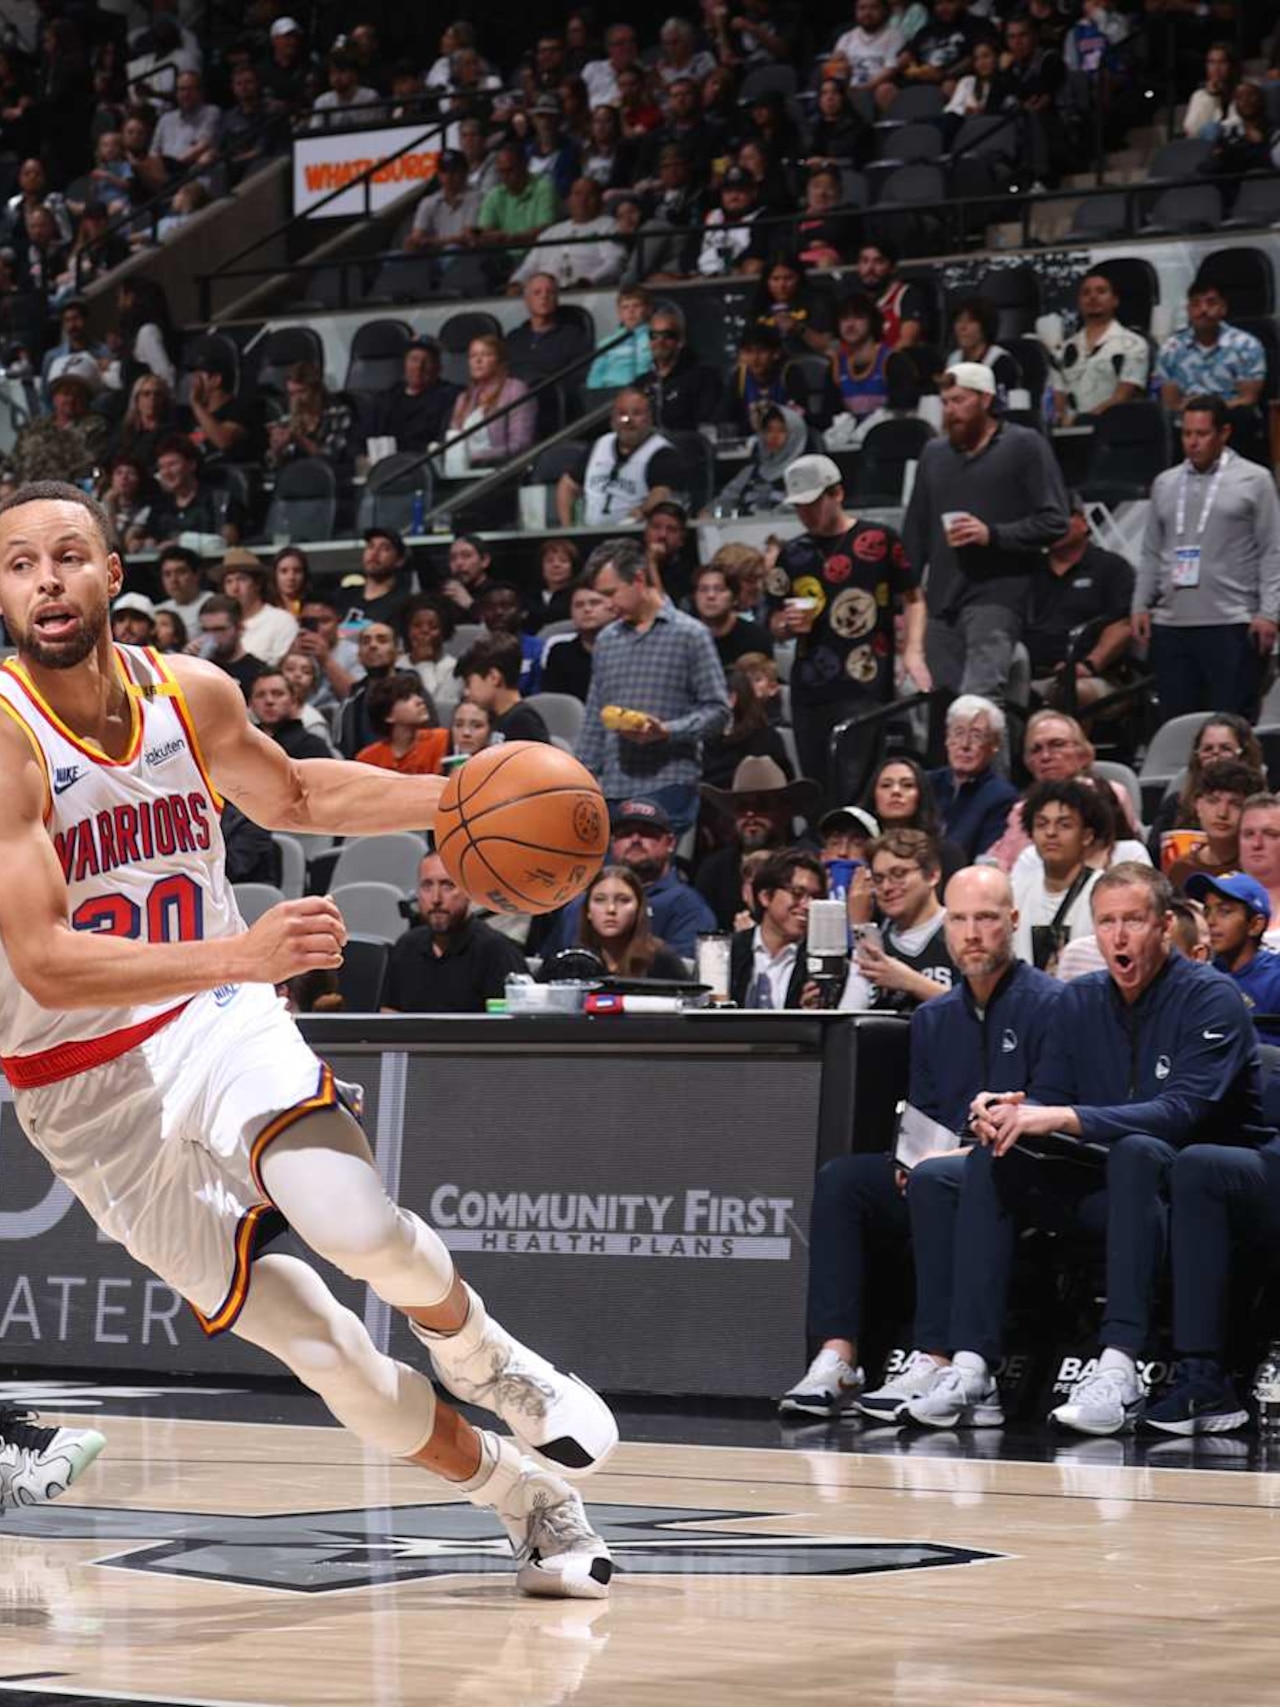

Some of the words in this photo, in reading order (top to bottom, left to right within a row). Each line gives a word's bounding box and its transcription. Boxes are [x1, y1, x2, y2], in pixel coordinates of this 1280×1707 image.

[430, 1184, 673, 1231] COMMUNITY
[684, 1190, 793, 1235] FIRST
[482, 1232, 606, 1253] HEALTH
[629, 1236, 734, 1256] PLANS
